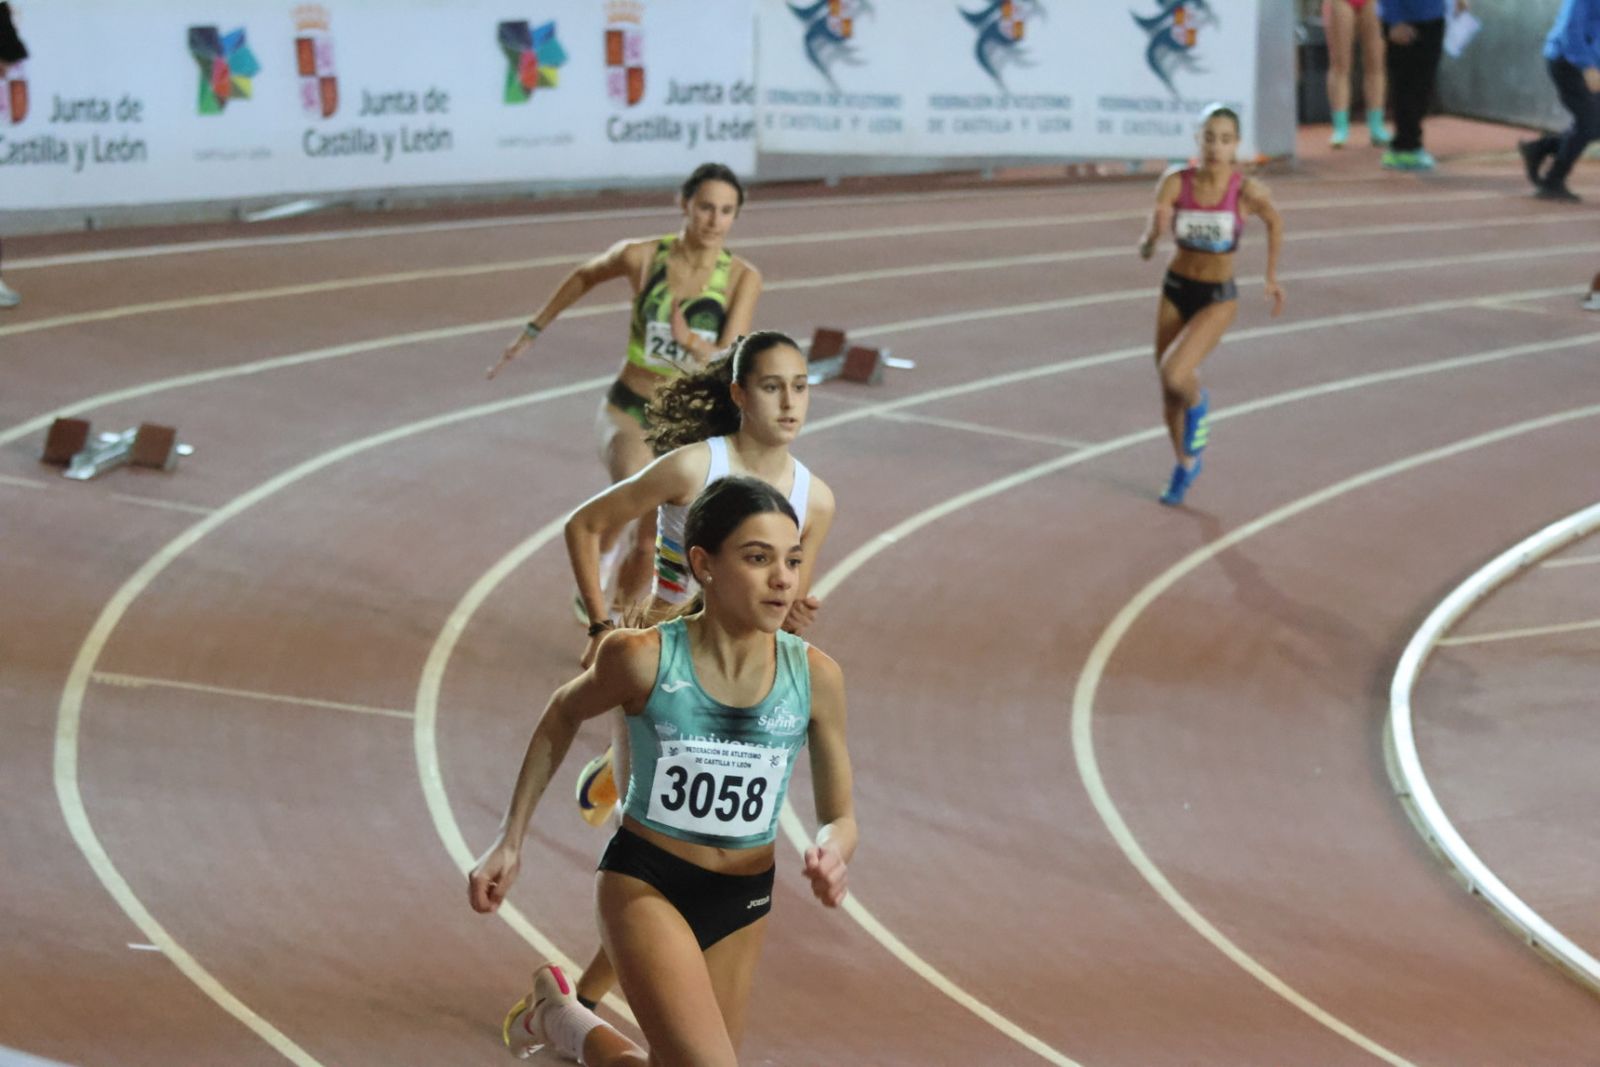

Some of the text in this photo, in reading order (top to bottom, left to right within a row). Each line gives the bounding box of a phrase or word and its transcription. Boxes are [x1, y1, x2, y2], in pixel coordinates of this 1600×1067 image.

[49, 94, 143, 122] Junta de
[359, 88, 450, 117] Junta de
[663, 79, 756, 106] Junta de
[303, 127, 379, 156] Castilla
[383, 133, 396, 163] y
[401, 125, 453, 152] León
[607, 115, 682, 143] Castilla
[686, 122, 699, 149] y
[74, 141, 88, 173] y
[93, 134, 148, 163] León
[704, 758, 730, 767] CASTILLA
[660, 765, 768, 822] 3058
